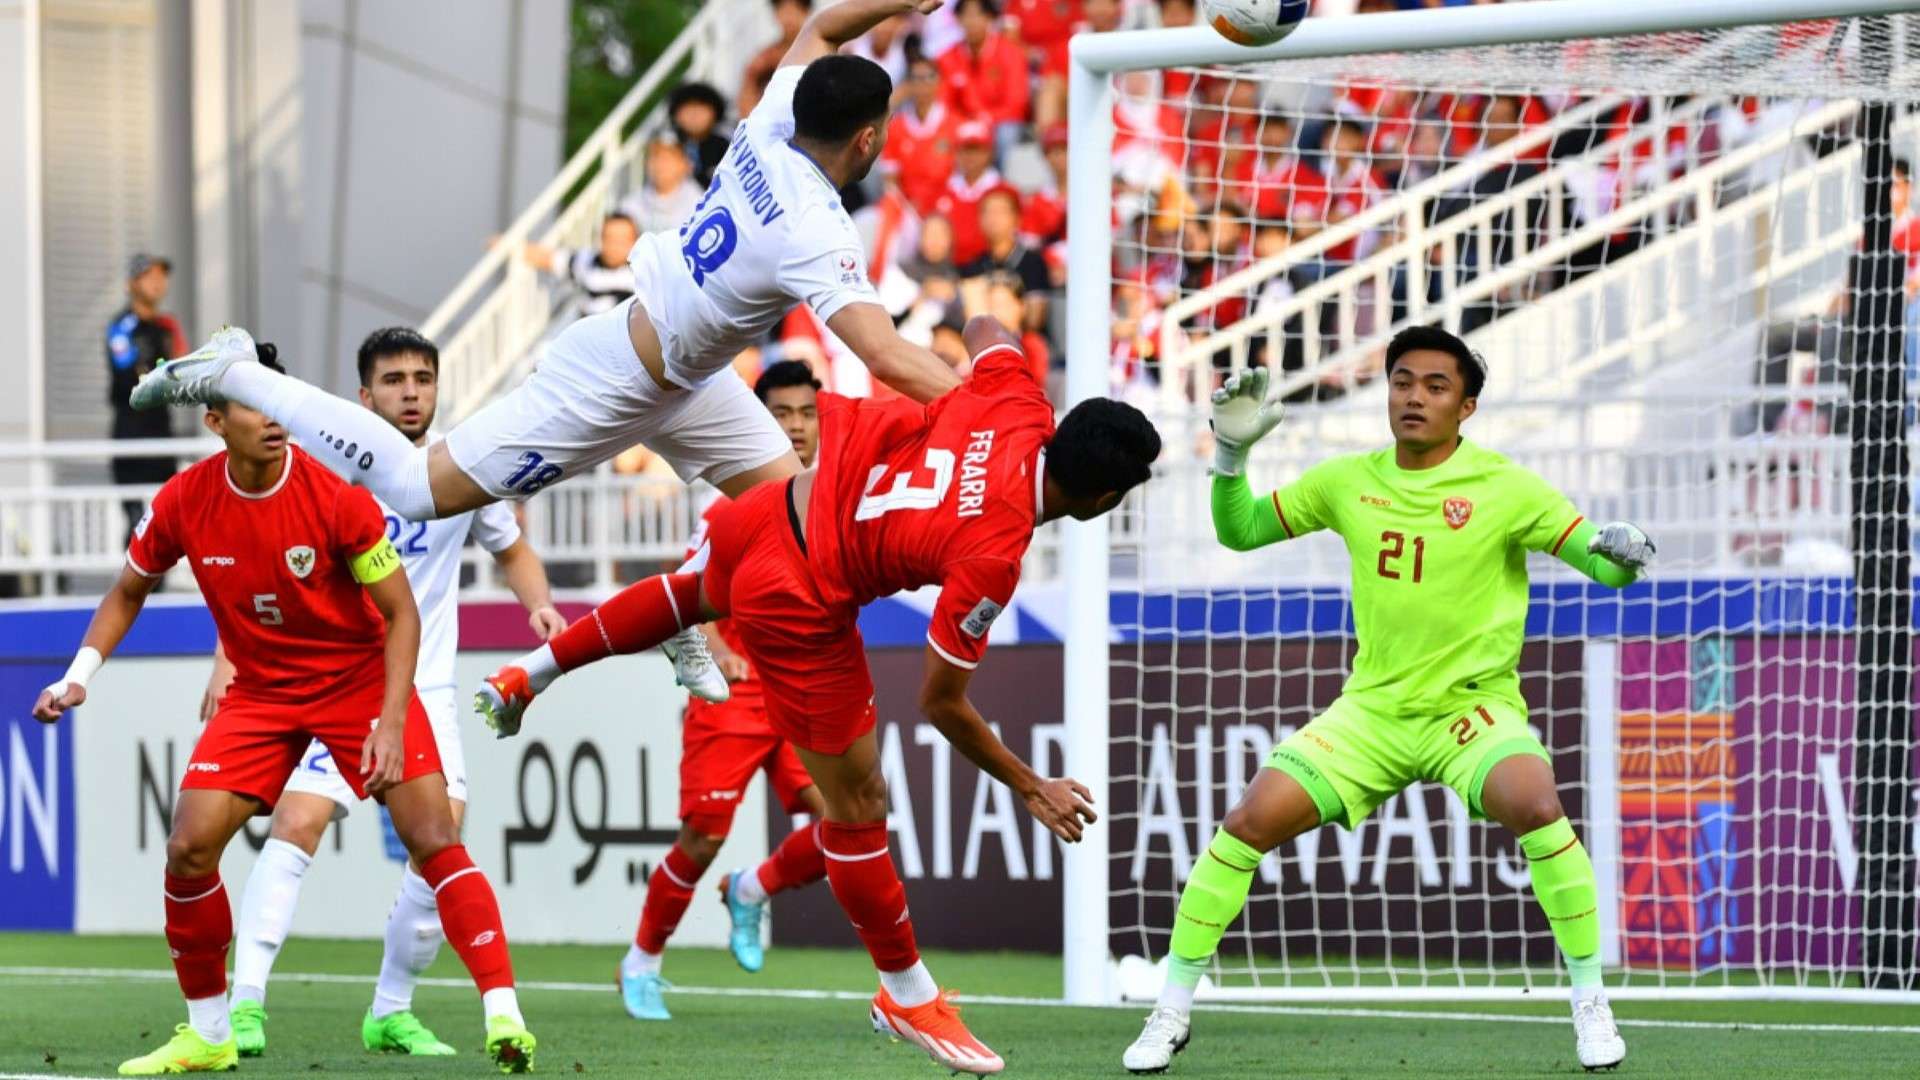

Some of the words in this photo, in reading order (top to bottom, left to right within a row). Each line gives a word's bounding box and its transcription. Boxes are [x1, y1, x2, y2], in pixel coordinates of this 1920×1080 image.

[501, 451, 564, 496] 18
[855, 448, 956, 522] 3
[957, 430, 996, 517] FERARRI
[202, 556, 235, 567] erspo
[1377, 530, 1425, 584] 21
[254, 593, 284, 625] 5
[1449, 704, 1495, 746] 21
[793, 721, 1068, 881] ATAR
